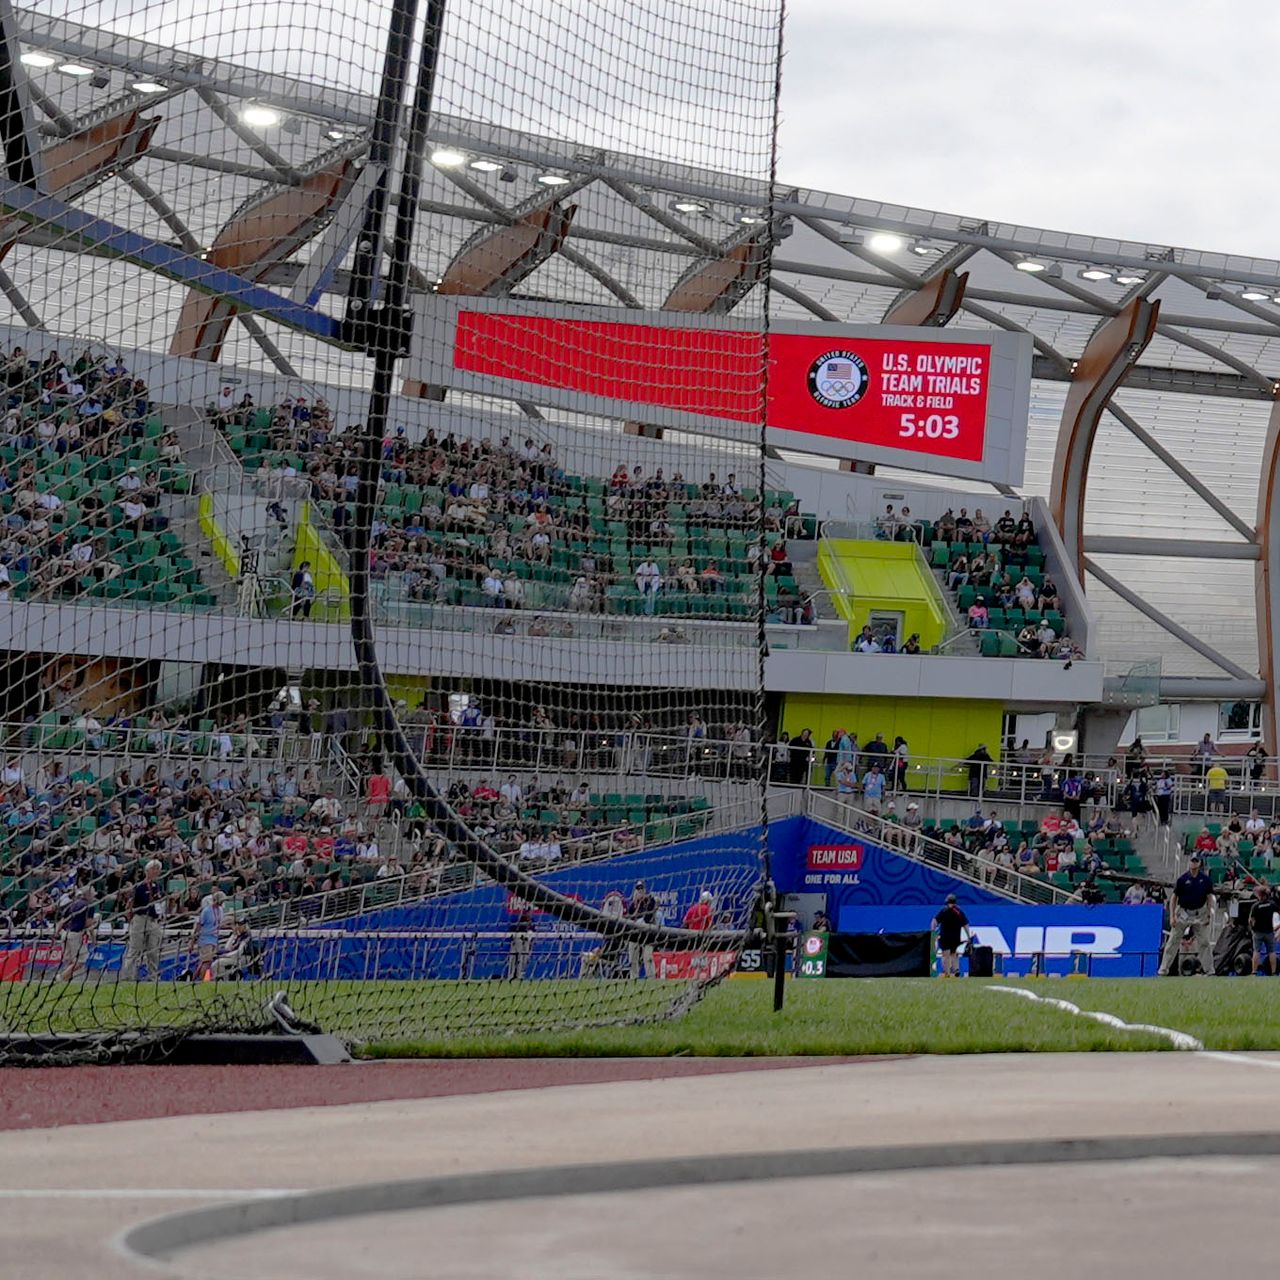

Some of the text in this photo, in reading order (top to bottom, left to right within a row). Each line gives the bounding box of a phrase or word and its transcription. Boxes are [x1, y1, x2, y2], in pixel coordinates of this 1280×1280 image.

[816, 350, 865, 368] UNITED STATES
[882, 353, 982, 375] U.S. OLYMPIC
[881, 373, 981, 395] TEAM TRIALS
[881, 394, 953, 409] TRACK & FIELD
[899, 413, 960, 439] 5:03
[812, 850, 857, 864] TEAM USA
[805, 874, 860, 884] ONE FOR ALL
